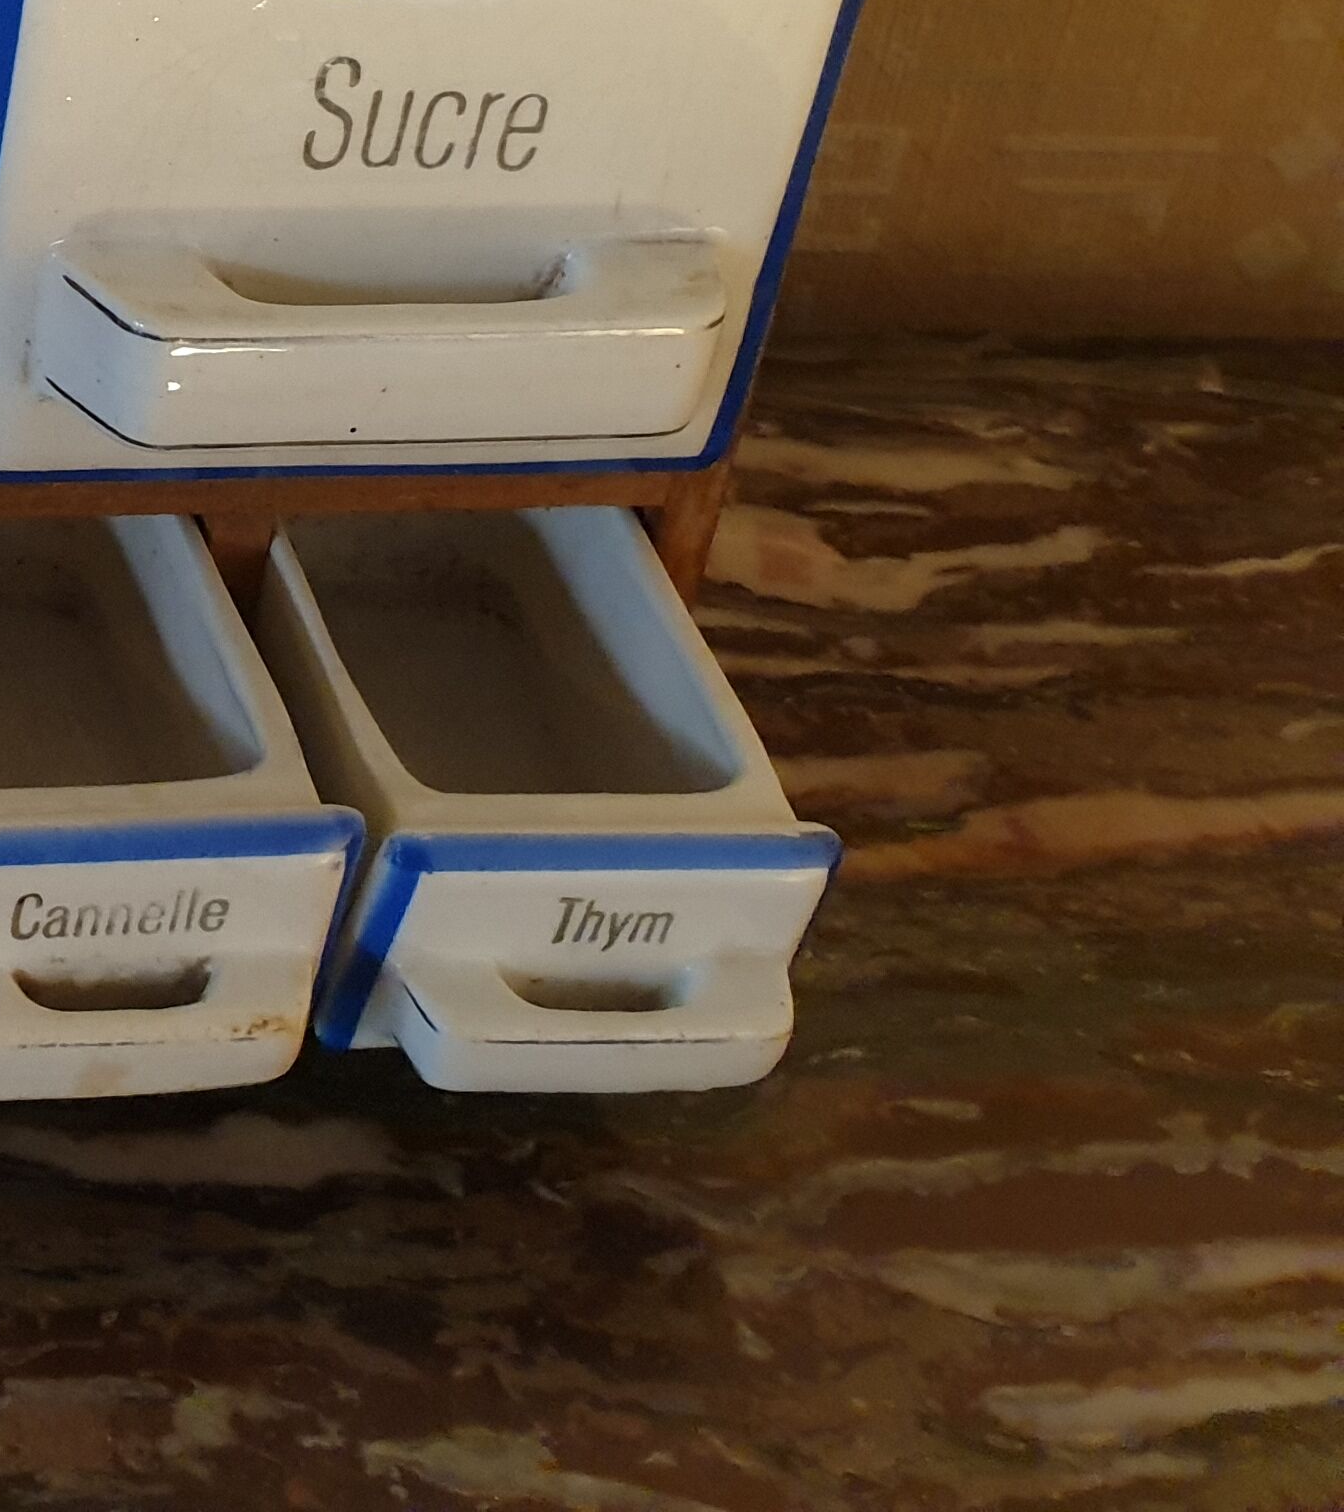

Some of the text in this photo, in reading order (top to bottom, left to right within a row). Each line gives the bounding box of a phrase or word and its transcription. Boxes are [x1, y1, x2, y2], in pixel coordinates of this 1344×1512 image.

[302, 56, 549, 172] Sucre
[10, 888, 231, 940] Cannelle
[551, 896, 675, 952] Thym
